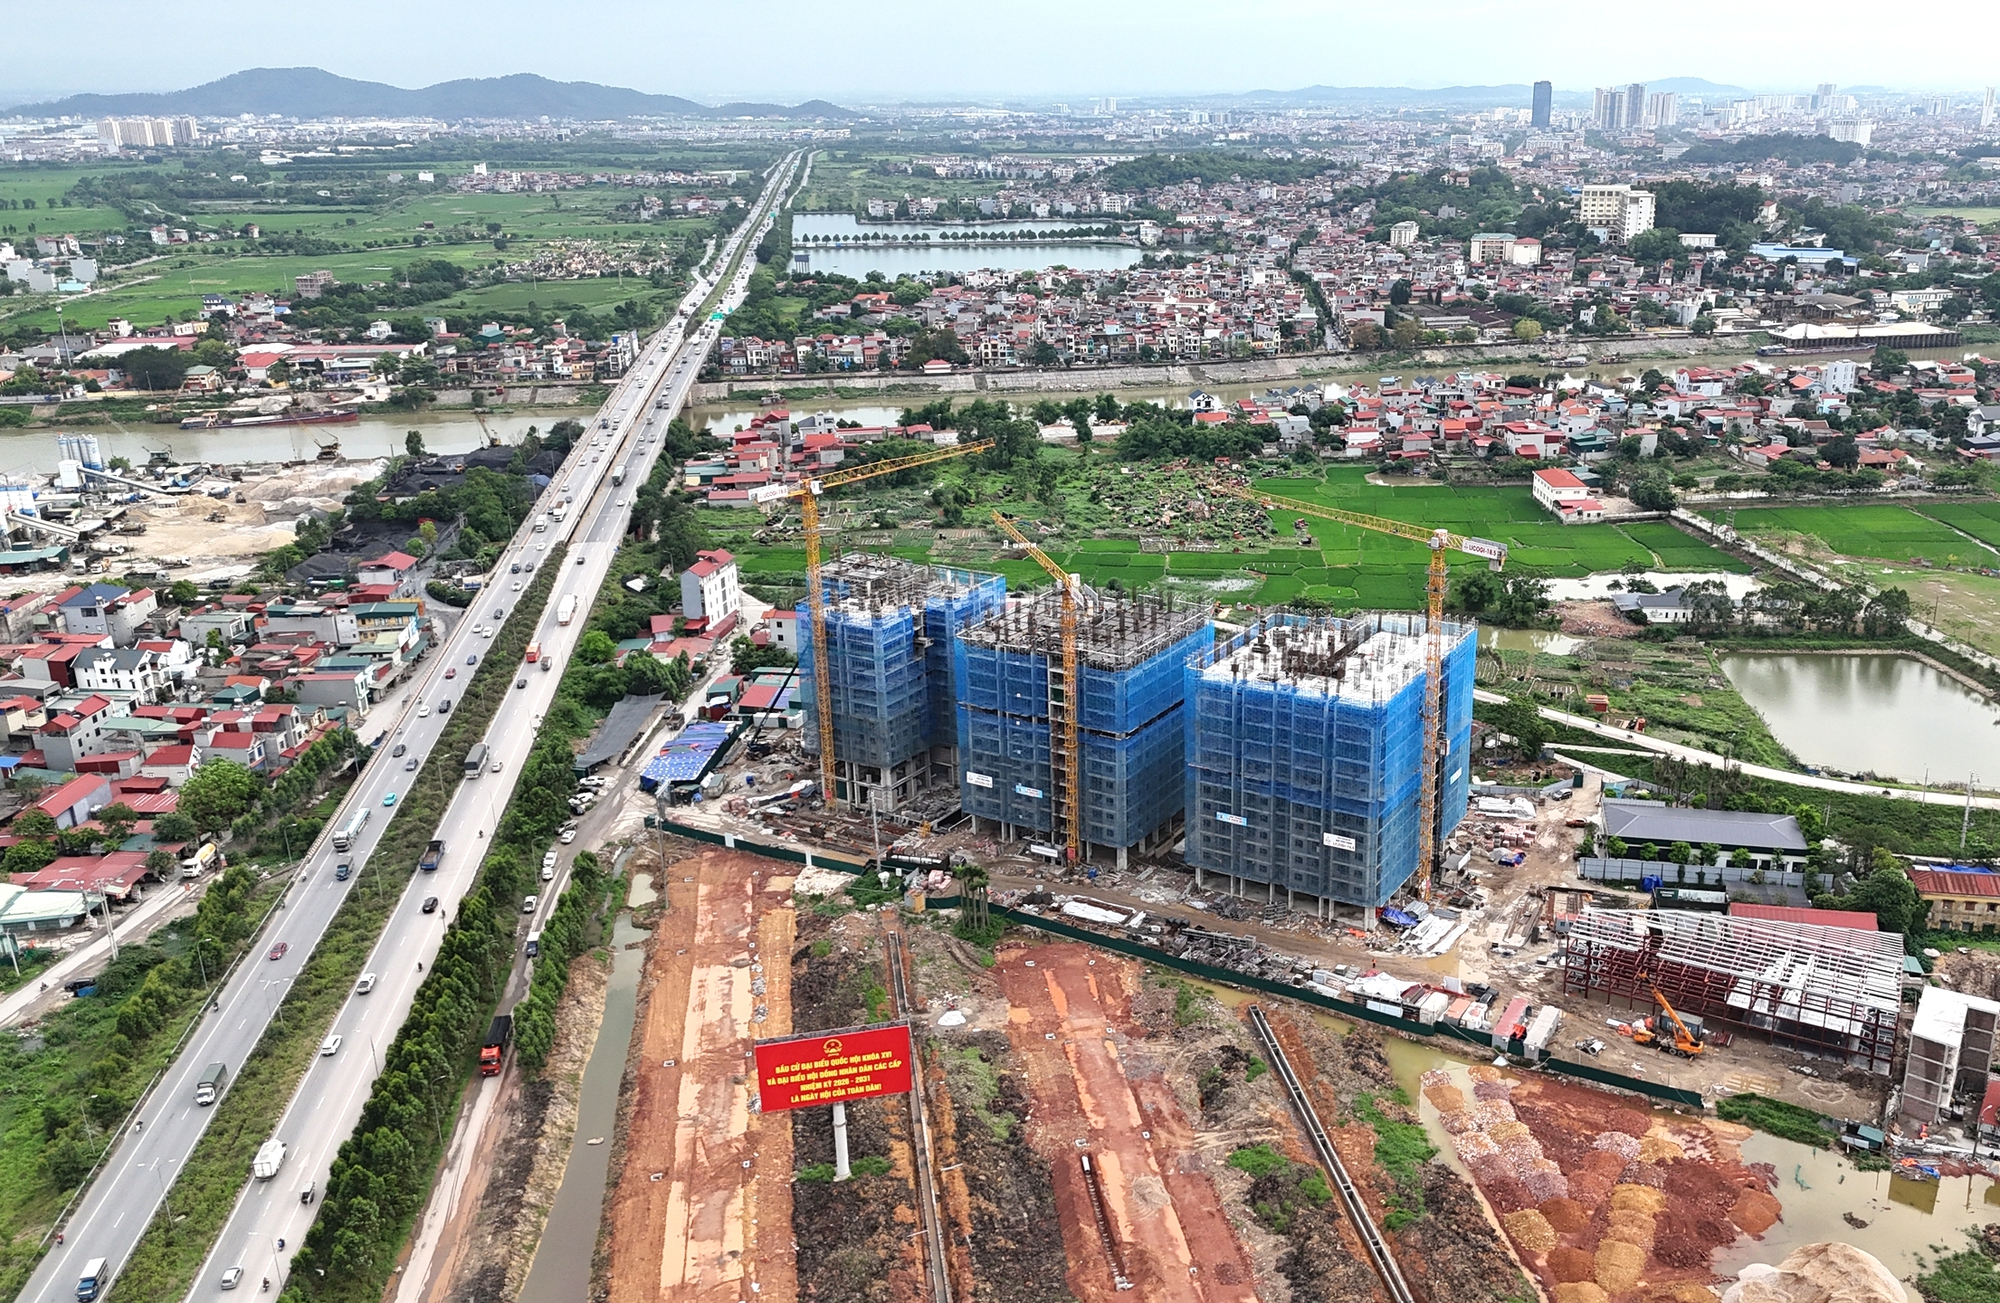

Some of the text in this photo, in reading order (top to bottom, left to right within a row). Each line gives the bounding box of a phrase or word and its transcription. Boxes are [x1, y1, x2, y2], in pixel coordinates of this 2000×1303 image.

[850, 1055, 861, 1064] HỘI
[807, 1072, 818, 1080] HỘI
[839, 1067, 858, 1075] NHÂN
[859, 1064, 873, 1072] DÂN
[874, 1062, 887, 1070] CÁC
[888, 1059, 902, 1068] CẤP
[855, 1075, 870, 1083] 2031
[791, 1095, 799, 1103] LÀ
[801, 1093, 818, 1101] NGÀY
[820, 1091, 831, 1099] HỘI
[865, 1084, 881, 1092] DÂN!
